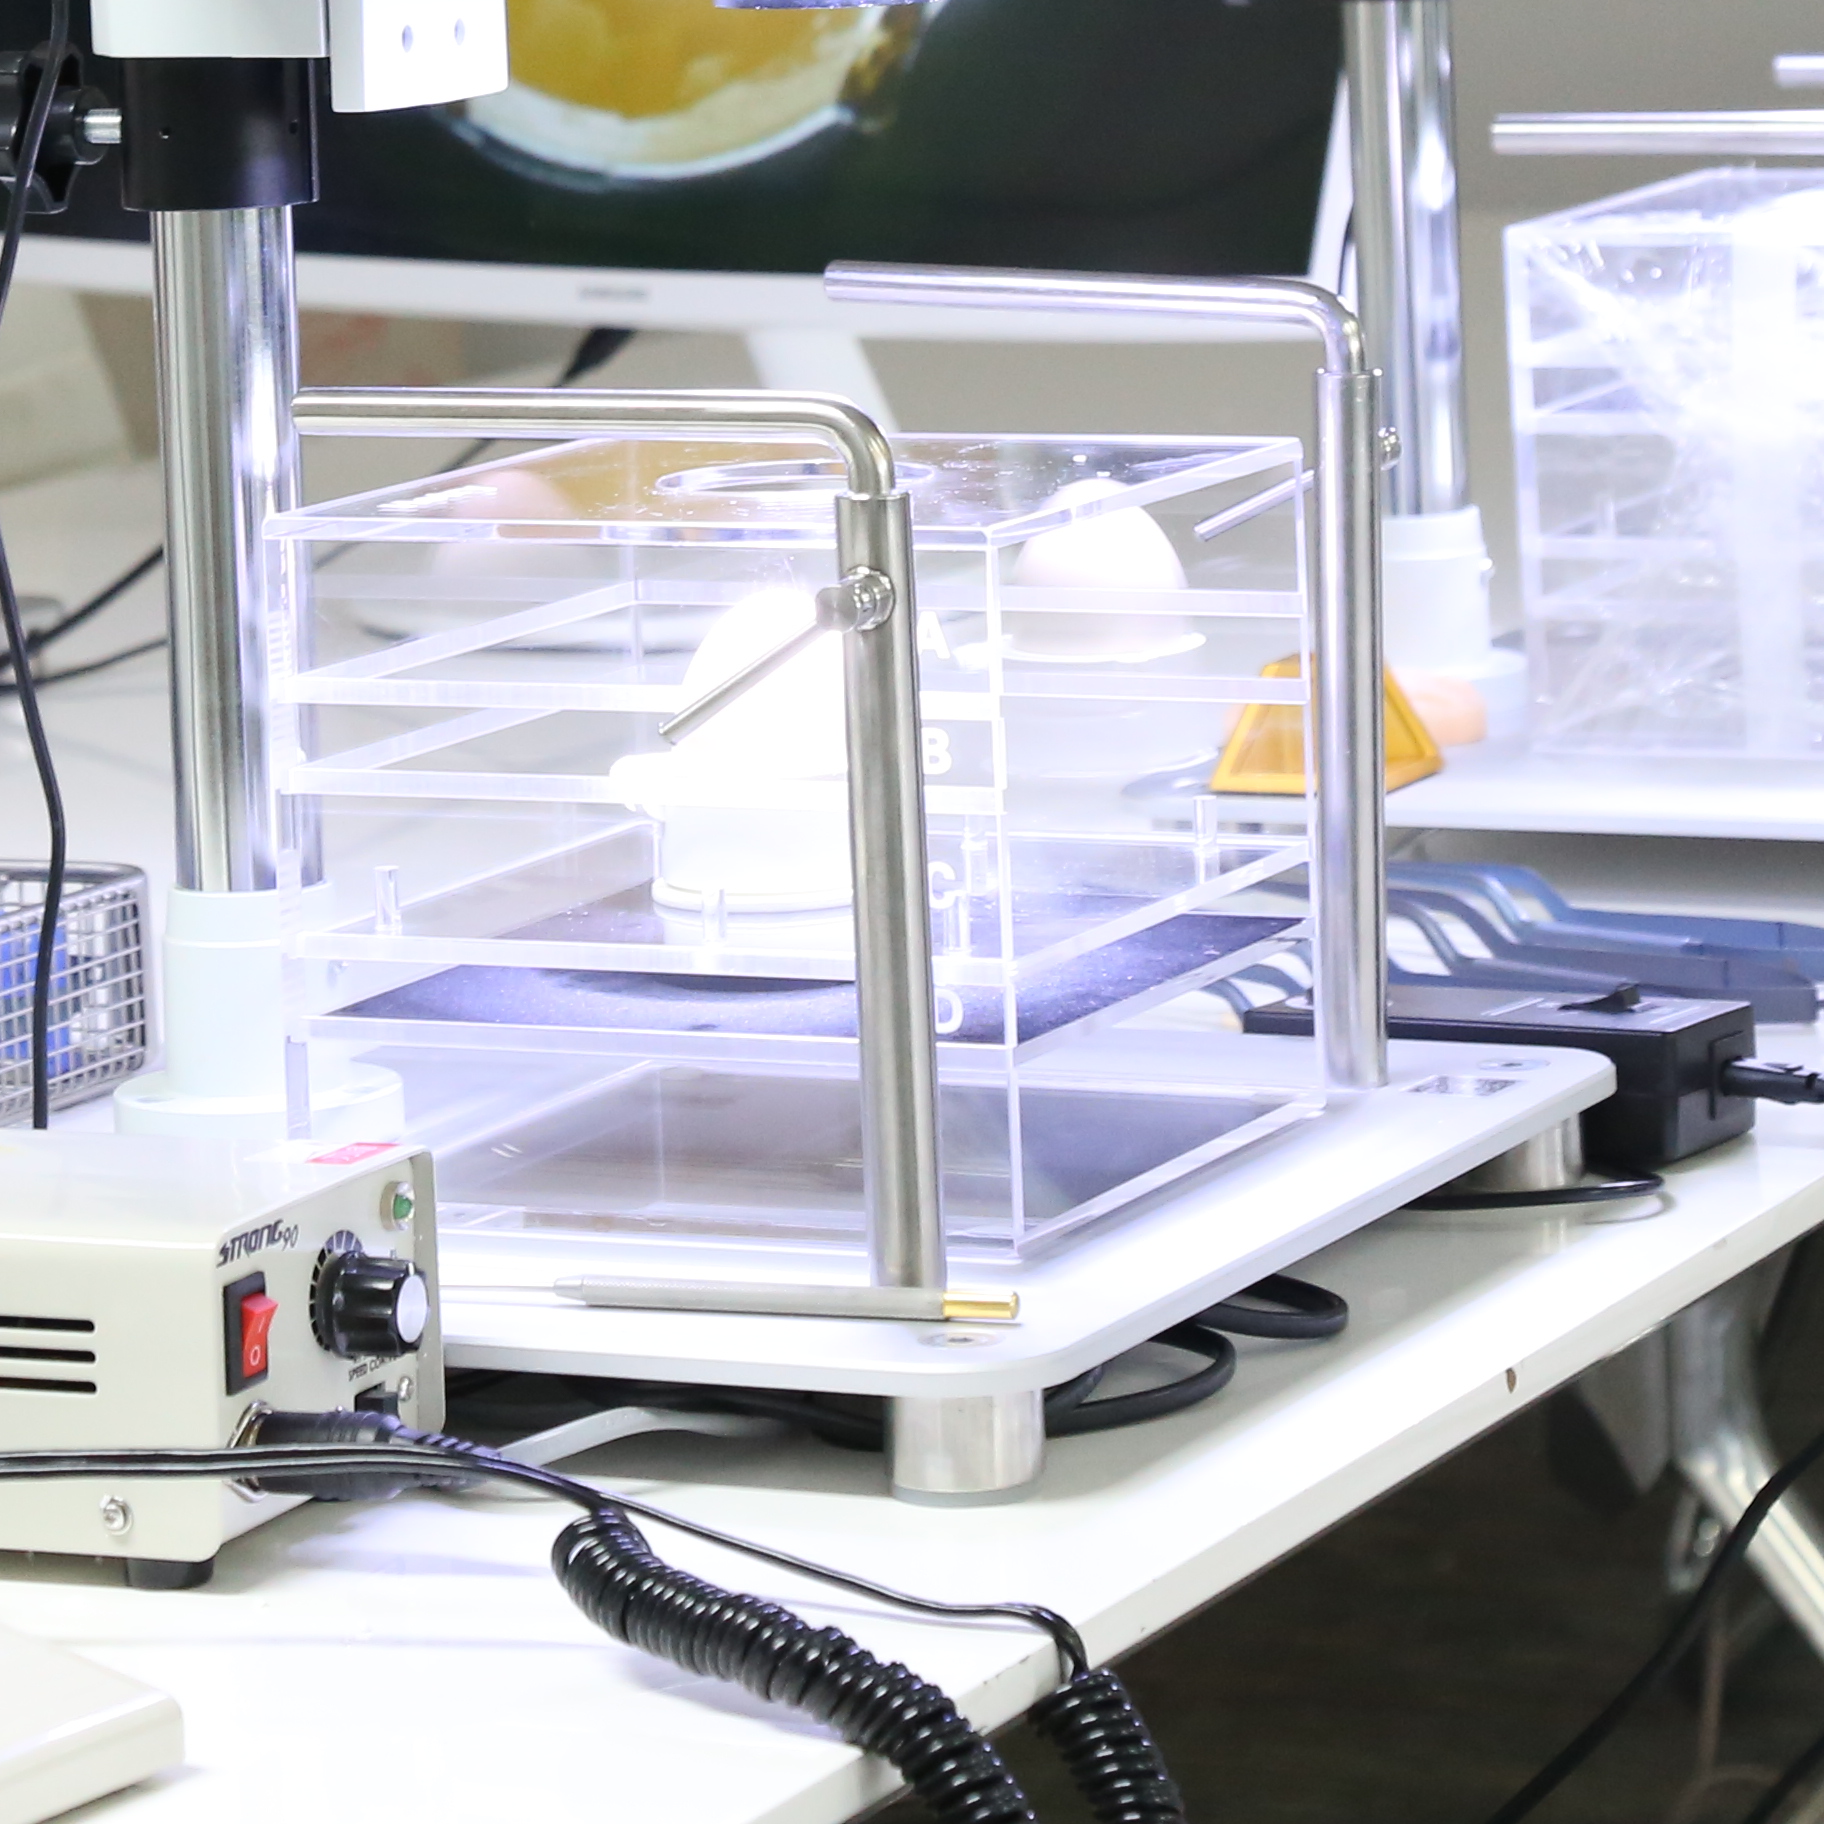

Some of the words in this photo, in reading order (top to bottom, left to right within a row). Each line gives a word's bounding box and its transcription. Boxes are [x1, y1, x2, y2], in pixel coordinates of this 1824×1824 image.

[916, 610, 951, 660] A
[921, 726, 953, 775] B
[928, 860, 957, 910] C
[934, 987, 964, 1035] D
